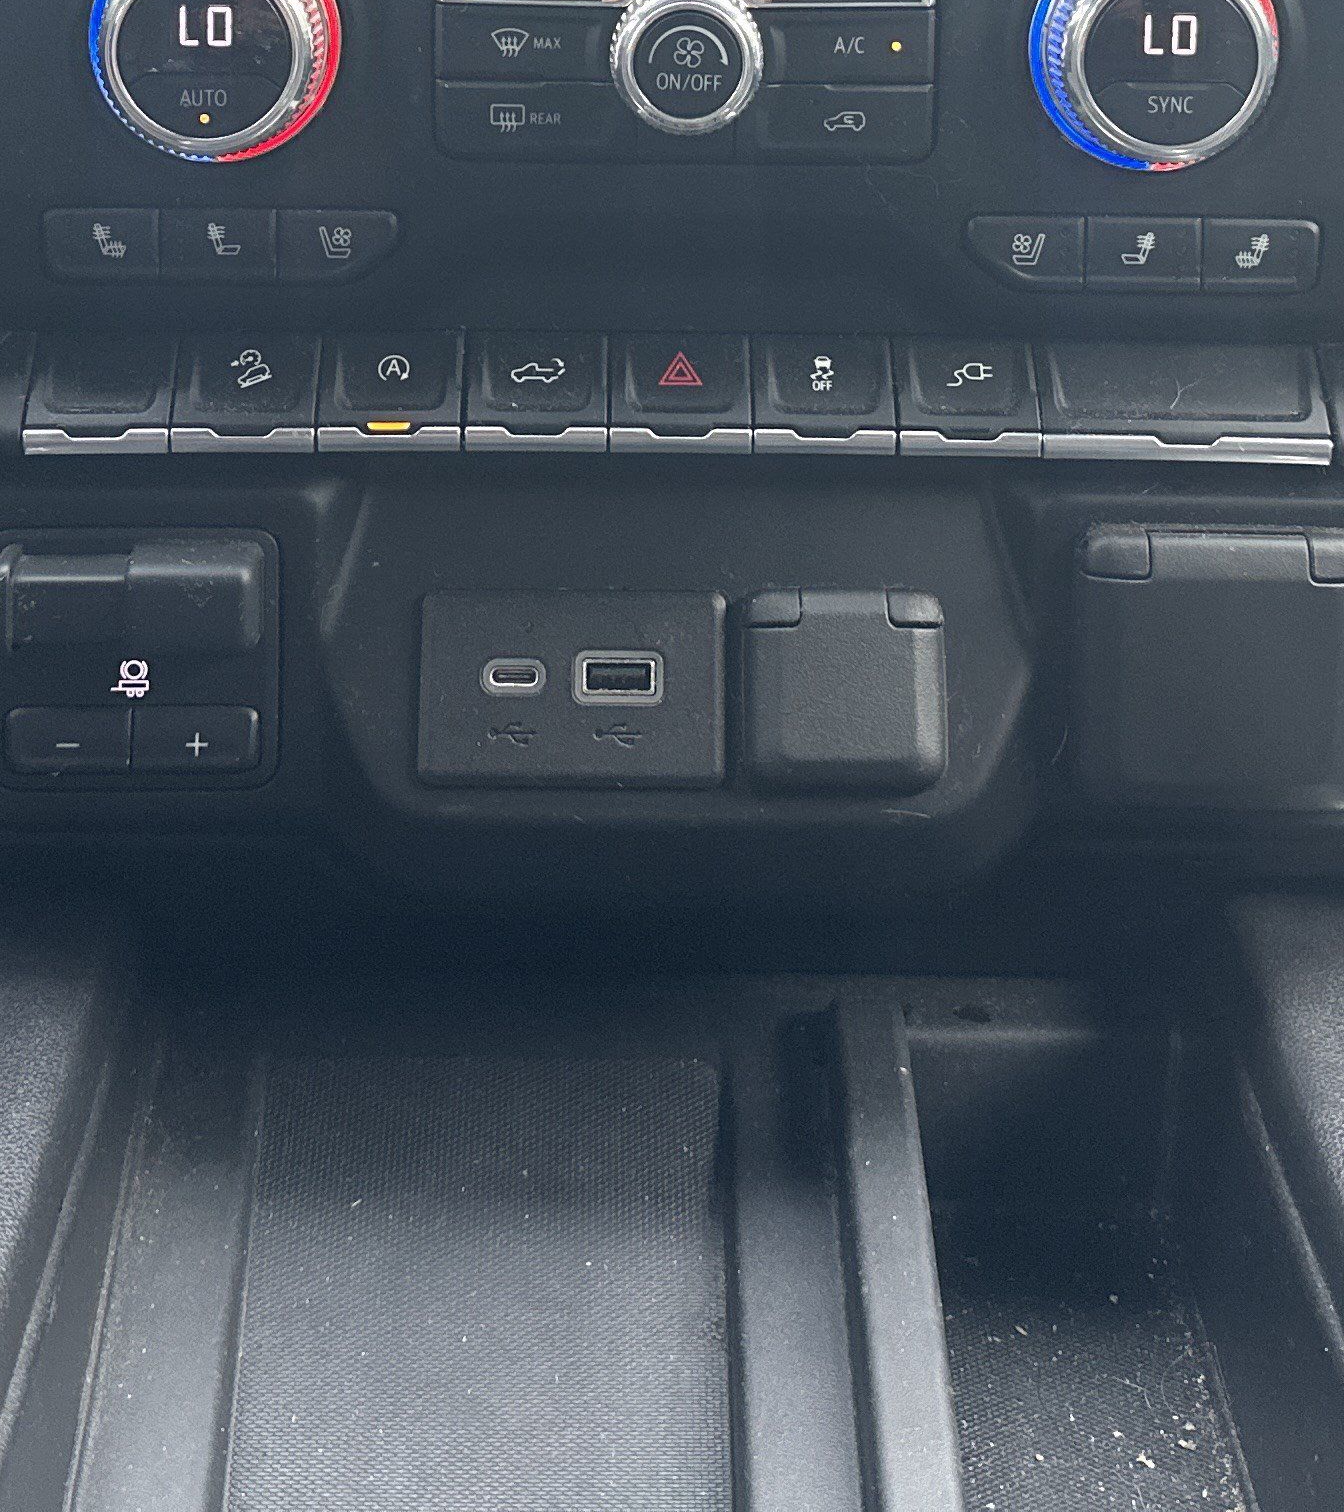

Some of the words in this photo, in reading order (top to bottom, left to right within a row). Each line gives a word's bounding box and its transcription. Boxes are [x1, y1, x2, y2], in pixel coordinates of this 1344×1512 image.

[179, 4, 233, 47] LO
[1143, 14, 1197, 55] LO
[533, 37, 562, 51] MAX
[833, 36, 866, 55] A/C
[656, 72, 724, 93] ON/OFF
[179, 88, 228, 107] AUTO
[1147, 95, 1194, 115] SYNC
[529, 112, 562, 126] REAR
[811, 380, 833, 392] OFF
